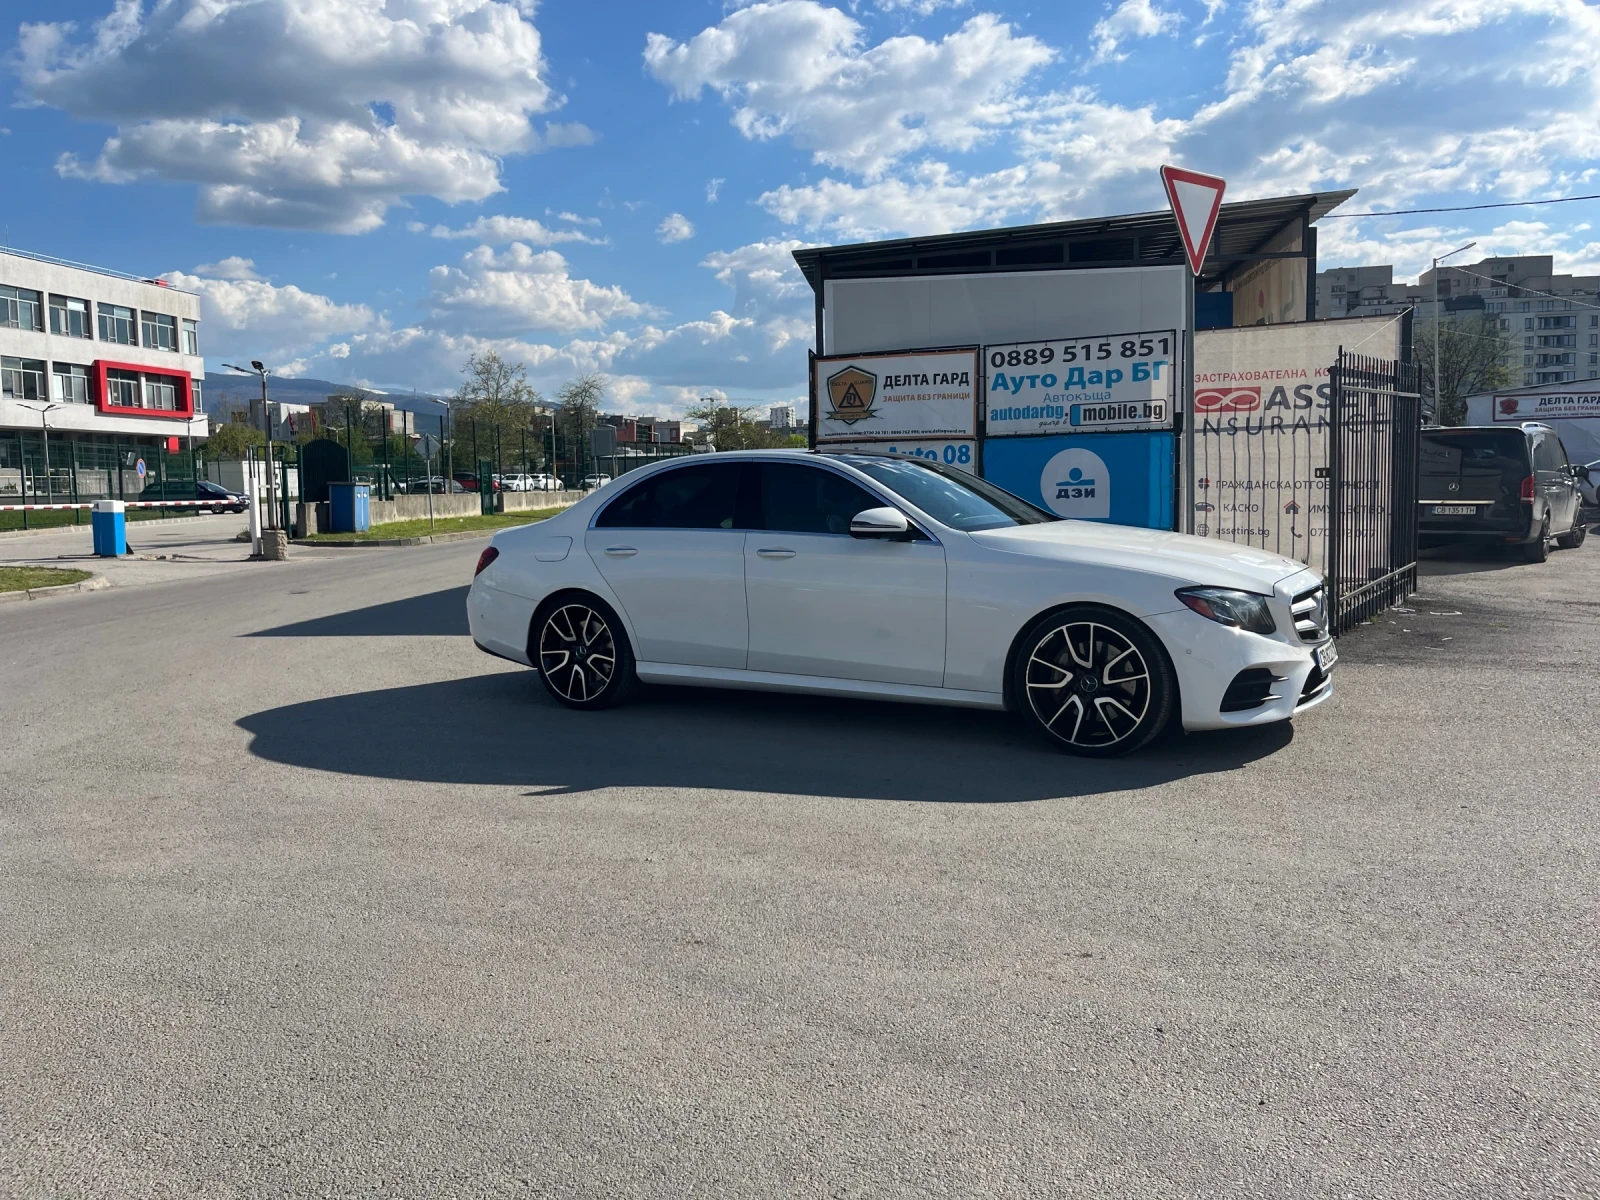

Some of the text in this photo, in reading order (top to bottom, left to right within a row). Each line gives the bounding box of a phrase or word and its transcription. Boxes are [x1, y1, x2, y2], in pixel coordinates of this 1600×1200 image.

[990, 337, 1169, 368] 0889 515 851
[883, 371, 969, 389] ДЕЛТА ГАРД
[990, 360, 1168, 395] Ауто Дар БГ
[1194, 368, 1308, 383] ЗАСТРАХОВАТЕЛНА
[882, 391, 970, 403] ЗАЩИТА БЕЗ ГРАНИЦИ
[1042, 390, 1112, 403] Автокъща
[1538, 397, 1575, 406] ДЕЛТА
[1083, 403, 1163, 421] mobile.bg
[1202, 413, 1386, 436] NSURANCE
[943, 444, 971, 464] 08
[1216, 480, 1291, 490] ГРАЖДАНСКА
[1055, 488, 1096, 499] ДЗИ
[1223, 503, 1259, 513] КАСКО
[1215, 526, 1270, 538] assetins.bg
